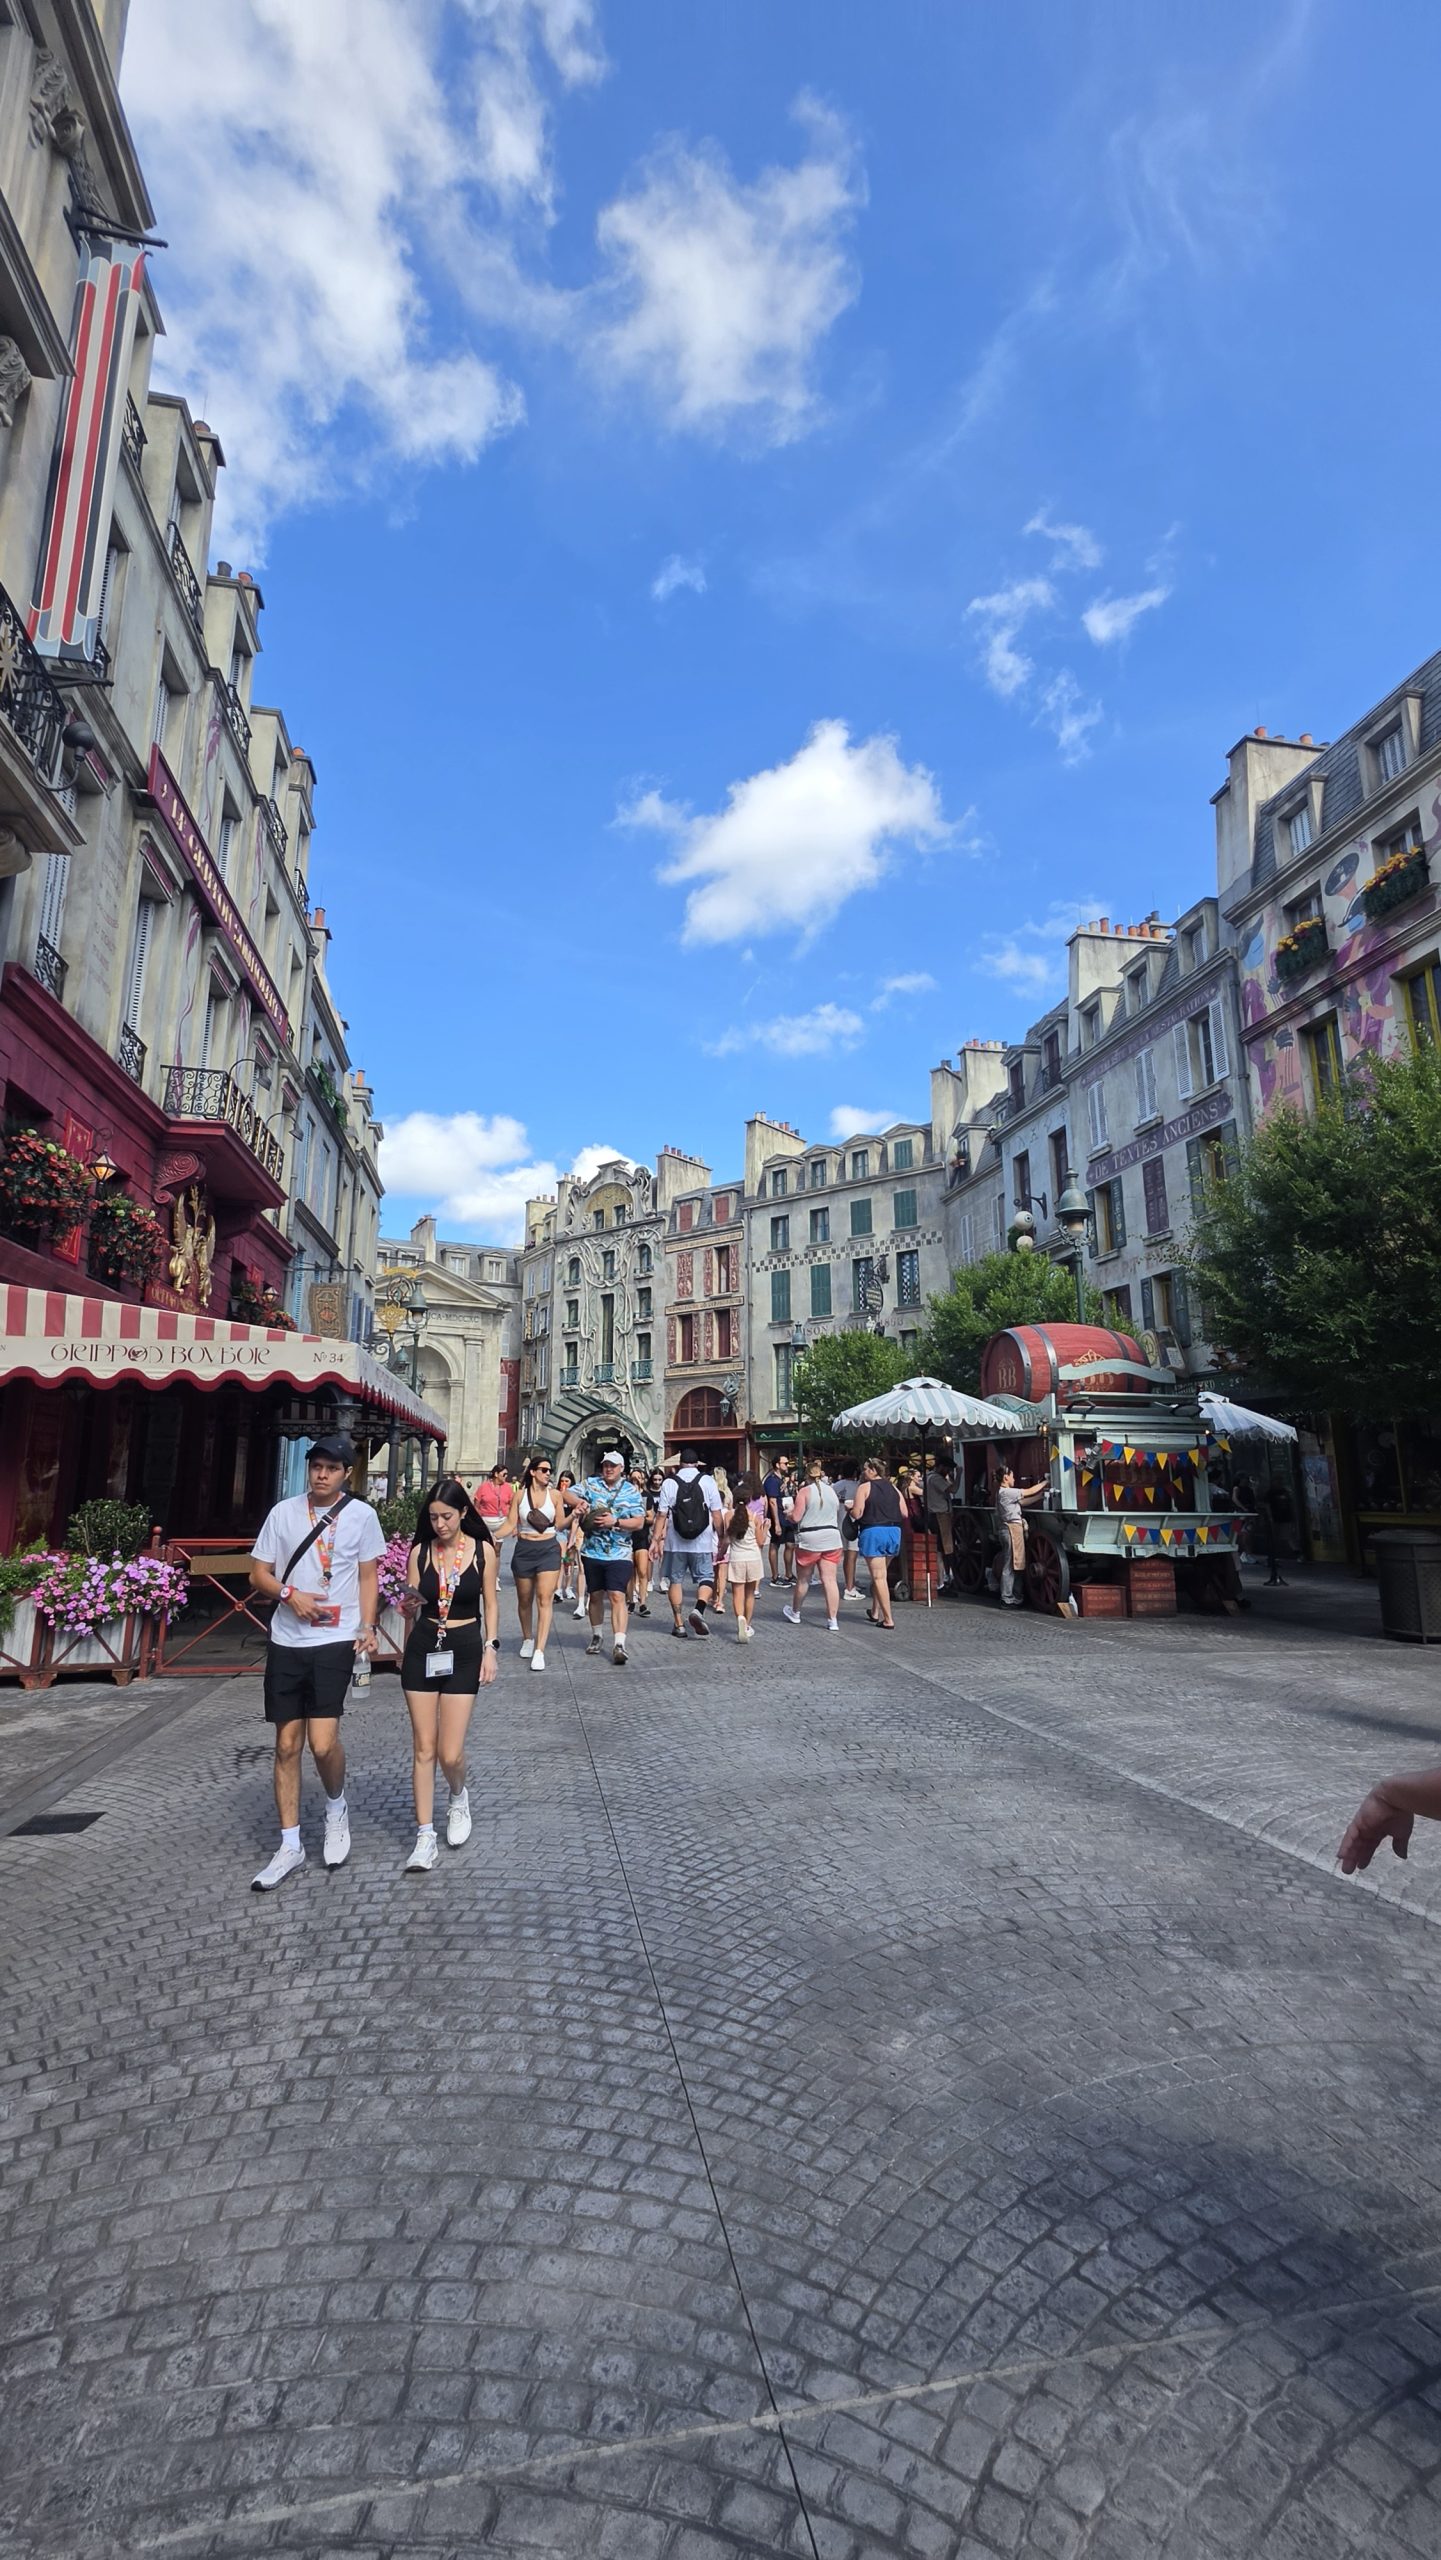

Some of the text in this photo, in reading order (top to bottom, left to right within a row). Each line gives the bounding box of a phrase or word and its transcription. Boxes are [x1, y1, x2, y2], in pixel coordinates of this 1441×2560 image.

[1095, 1102, 1219, 1179] DE TEXTES ANCIENS
[329, 1352, 345, 1364] 34
